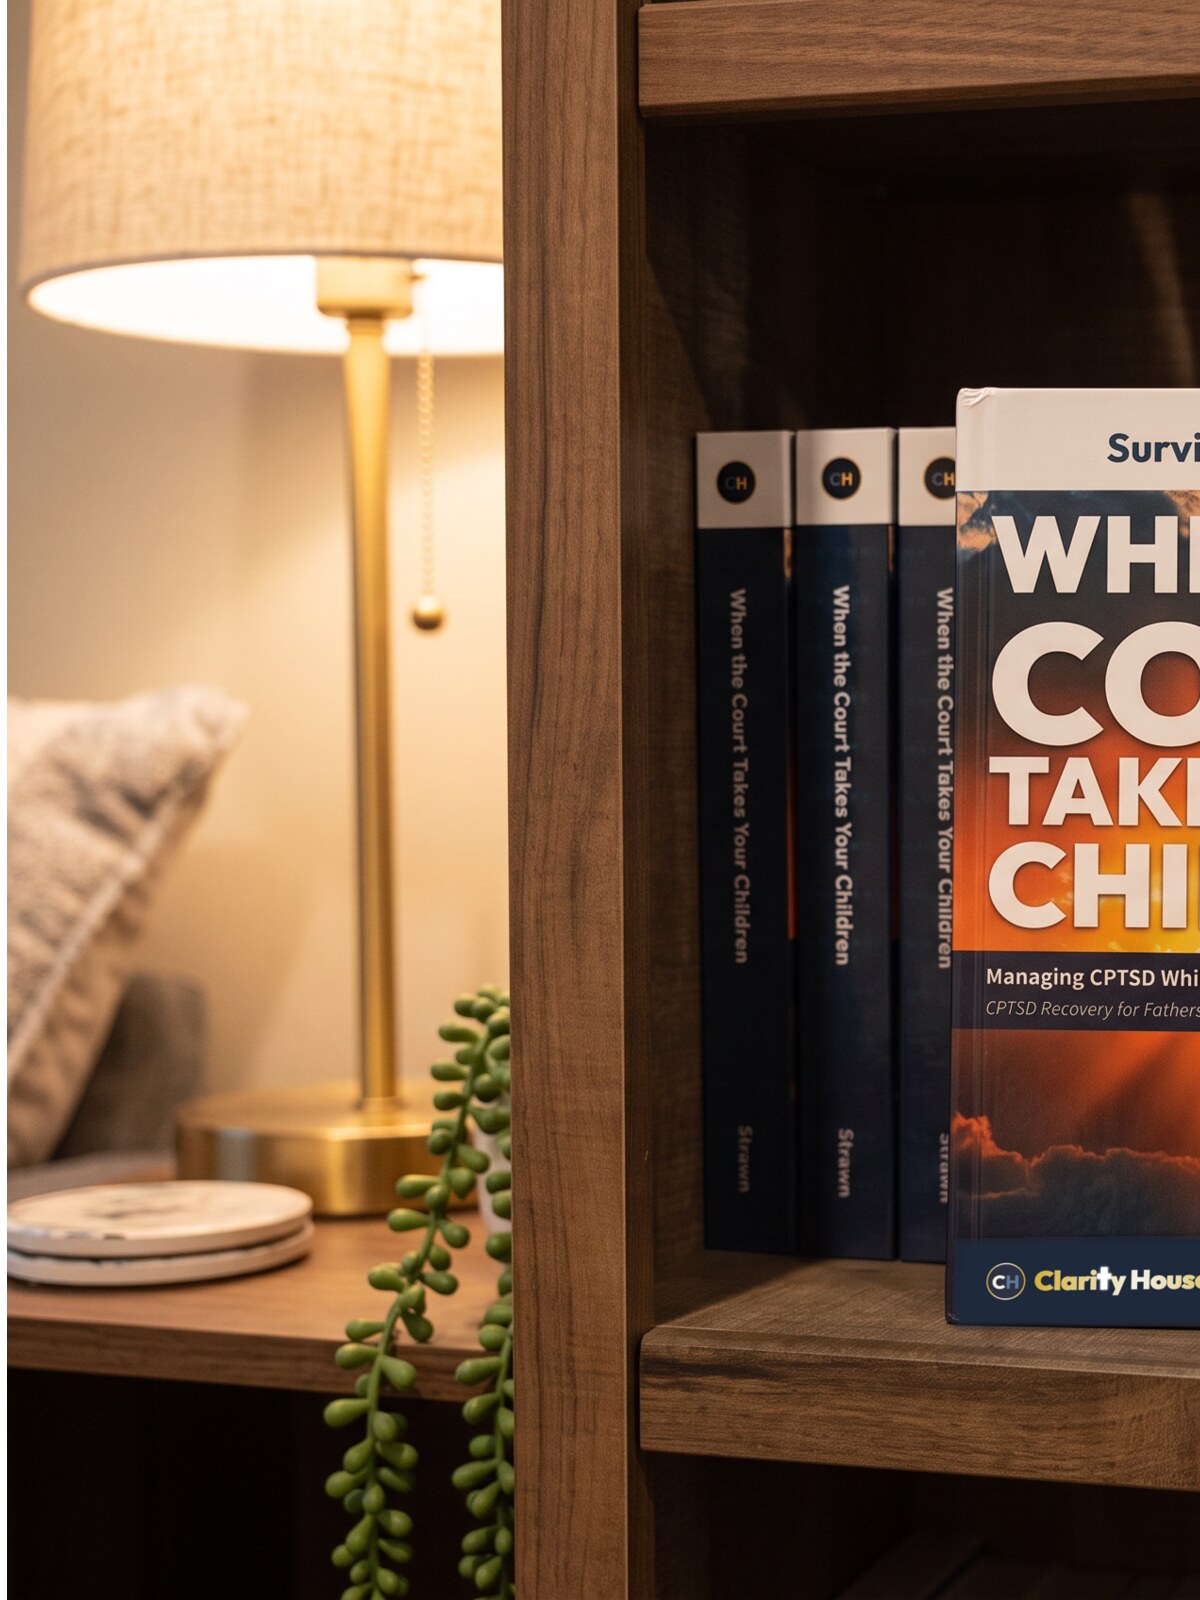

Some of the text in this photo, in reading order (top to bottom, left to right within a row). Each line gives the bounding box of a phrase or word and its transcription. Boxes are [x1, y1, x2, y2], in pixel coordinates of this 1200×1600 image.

[829, 471, 853, 487] CH
[931, 471, 955, 487] CH
[730, 588, 751, 964] When the Court Takes Your Children
[833, 585, 854, 966] When the Court Takes Your Children
[936, 587, 954, 969] When the Court Takes Your Children
[986, 968, 1085, 991] Managing
[1090, 969, 1155, 987] CPTSD
[986, 1000, 1037, 1015] CPTSD
[1041, 1001, 1113, 1020] Recovery
[1117, 1001, 1139, 1017] for
[737, 1125, 754, 1193] Strawn
[838, 1128, 855, 1198] Strawn
[991, 1274, 1019, 1290] CH
[1034, 1266, 1127, 1296] Clarity
